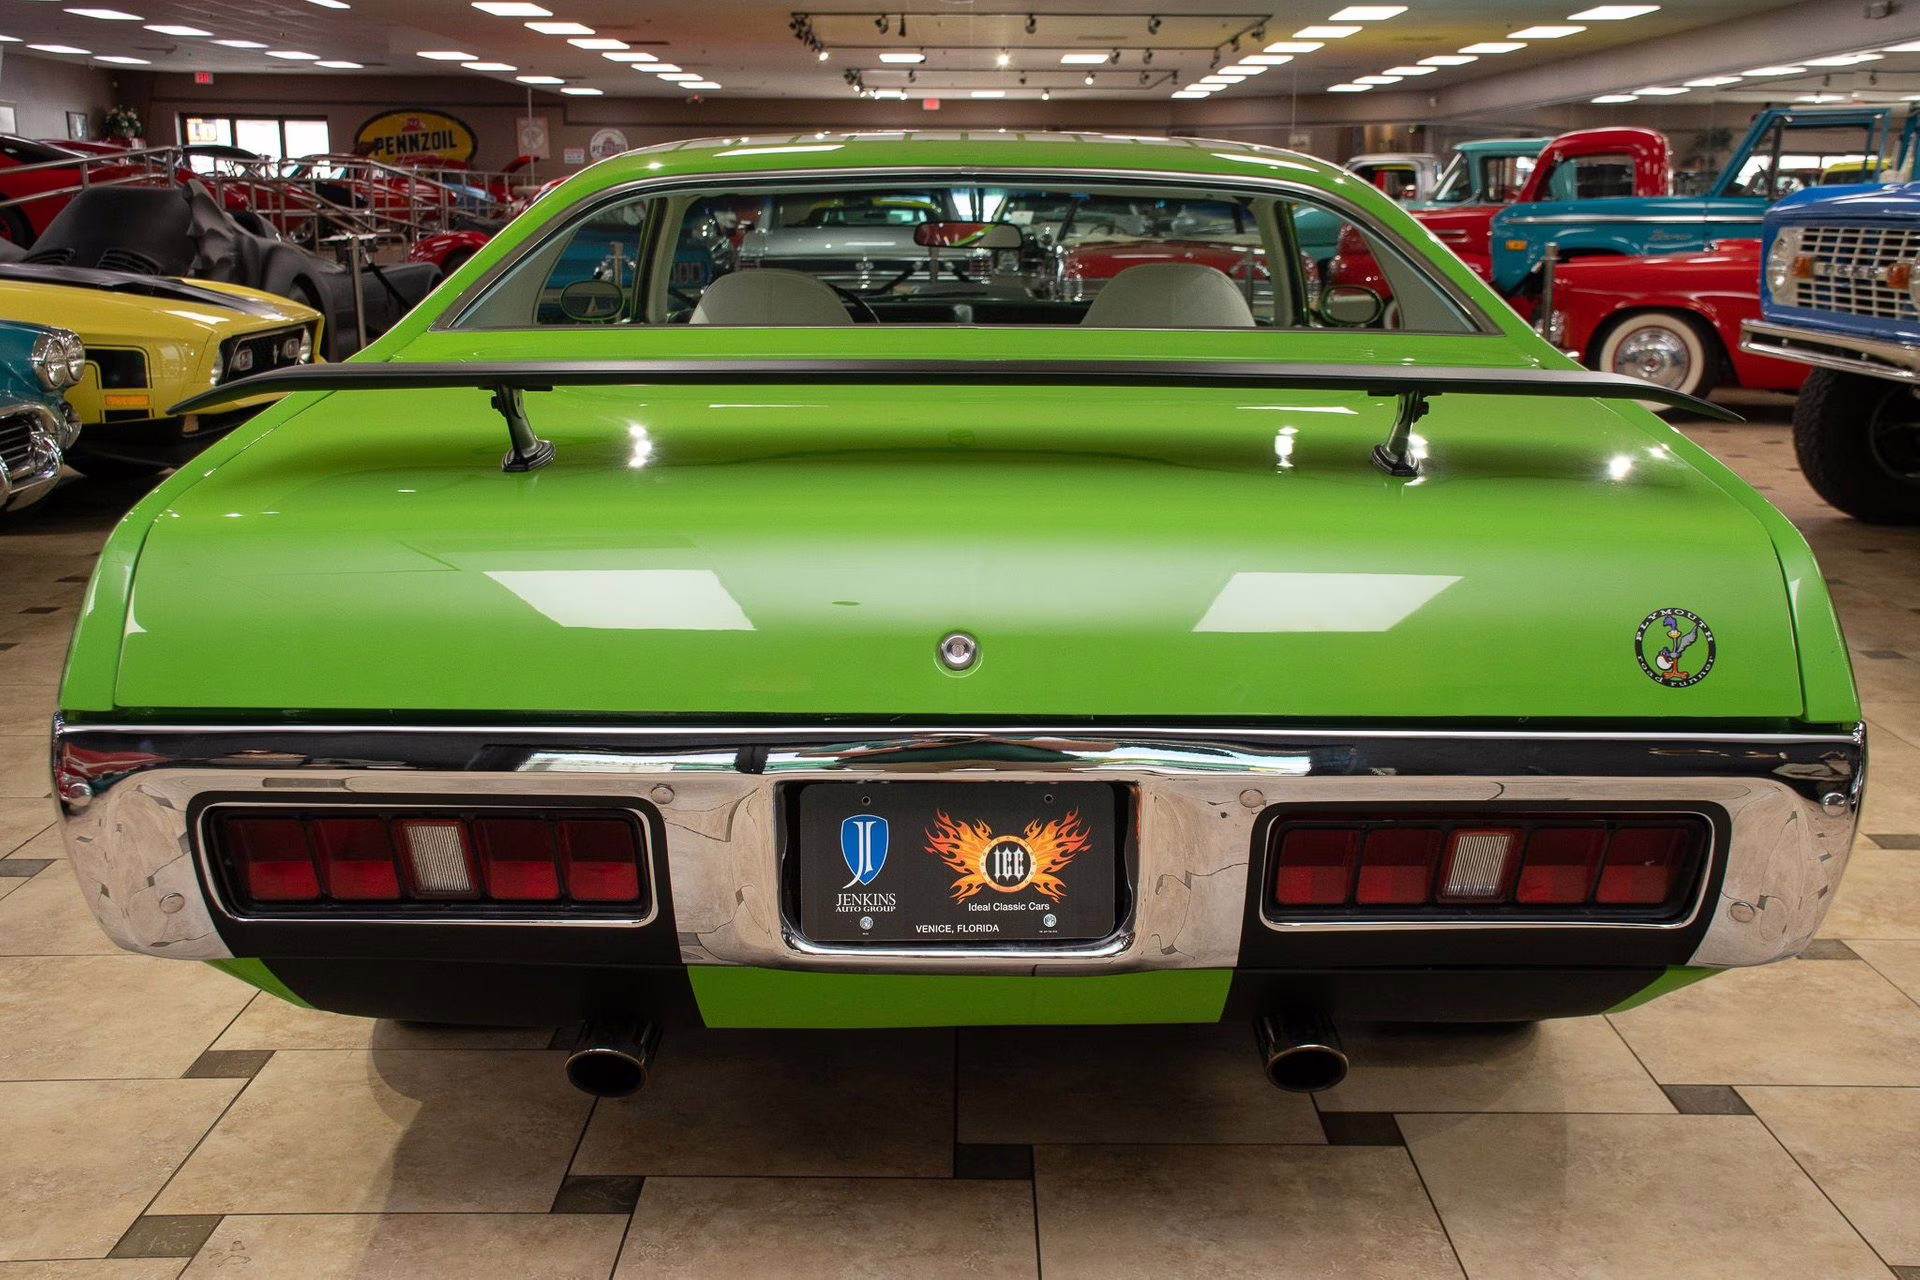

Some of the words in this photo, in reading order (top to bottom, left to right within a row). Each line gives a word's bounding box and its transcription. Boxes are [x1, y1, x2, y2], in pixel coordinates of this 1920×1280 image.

[374, 130, 457, 156] PENNZOIL
[1637, 609, 1714, 641] PLYMOUTH
[836, 893, 896, 906] JENKINS
[968, 903, 991, 912] Ideal
[993, 902, 1026, 911] Classic
[1028, 901, 1050, 910] Cars
[915, 925, 955, 934] VENICE,
[957, 923, 999, 933] FLORIDA
